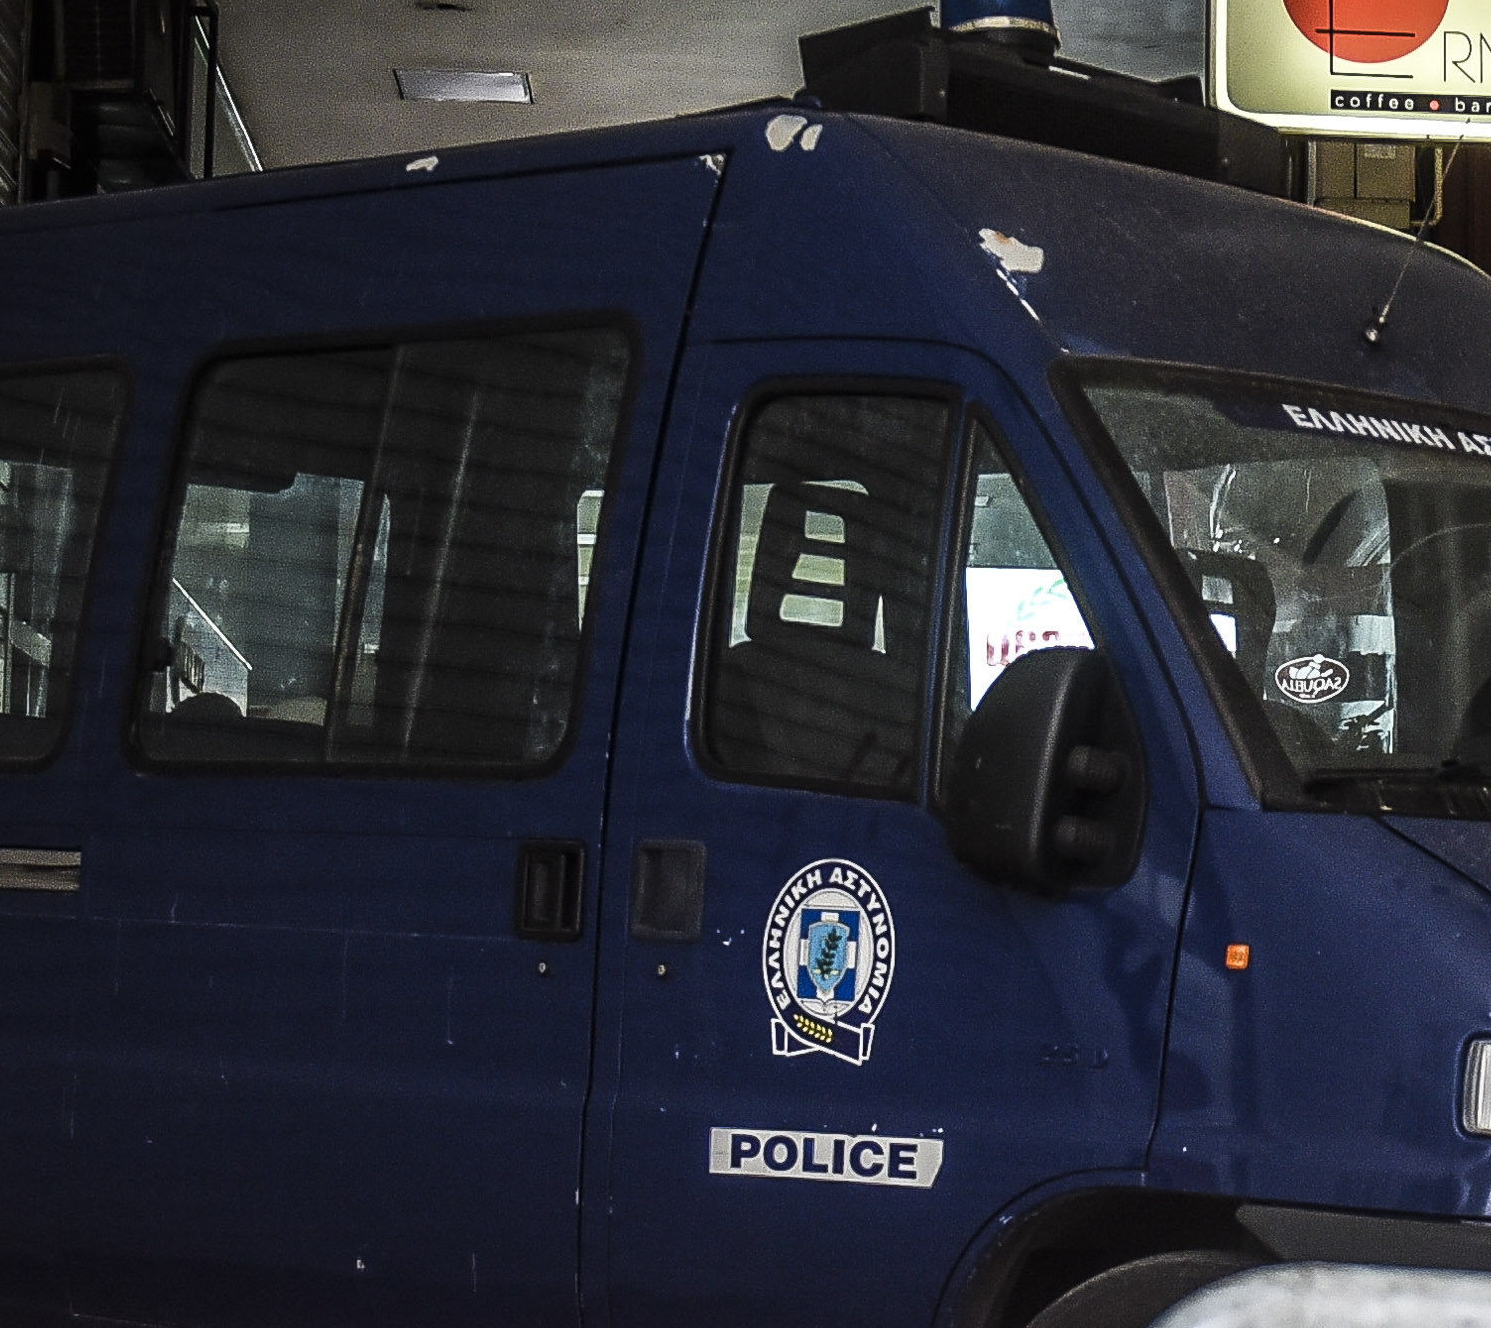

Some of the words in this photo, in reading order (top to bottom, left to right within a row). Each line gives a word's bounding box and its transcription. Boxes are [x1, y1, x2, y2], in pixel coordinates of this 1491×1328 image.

[1334, 93, 1415, 110] coffee
[1282, 404, 1457, 450] ΕΛΛΗΝΙΚΗ
[768, 869, 822, 1011] ΕΛΛΗΝΙΚΗ
[829, 867, 890, 1014] ΑΣΤΥΝΟΜΙΑ
[730, 1134, 919, 1180] POLICE
